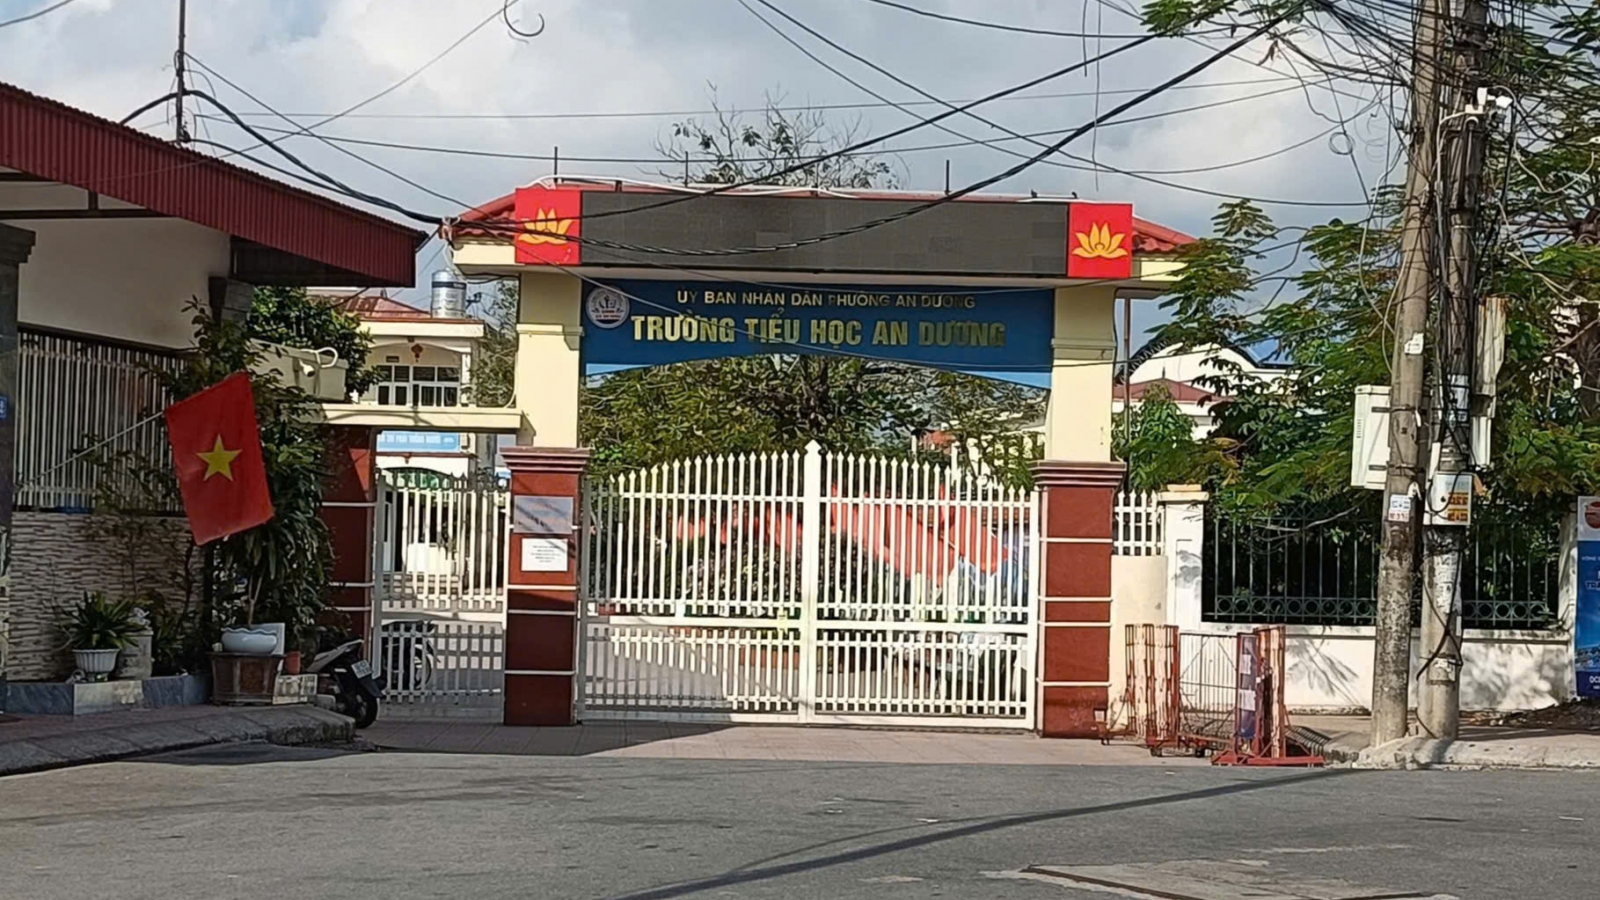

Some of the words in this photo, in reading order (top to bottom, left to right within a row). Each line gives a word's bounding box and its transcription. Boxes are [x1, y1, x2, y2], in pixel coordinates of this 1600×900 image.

[704, 291, 736, 305] BAN
[742, 290, 785, 306] NHÂN
[791, 291, 822, 306] DÂN
[895, 293, 916, 307] AN
[630, 309, 735, 343] TRƯỜNG
[744, 307, 800, 344] TIỂU
[810, 319, 862, 350] HỌC
[872, 320, 908, 346] AN
[918, 319, 1006, 347] DƯƠNG
